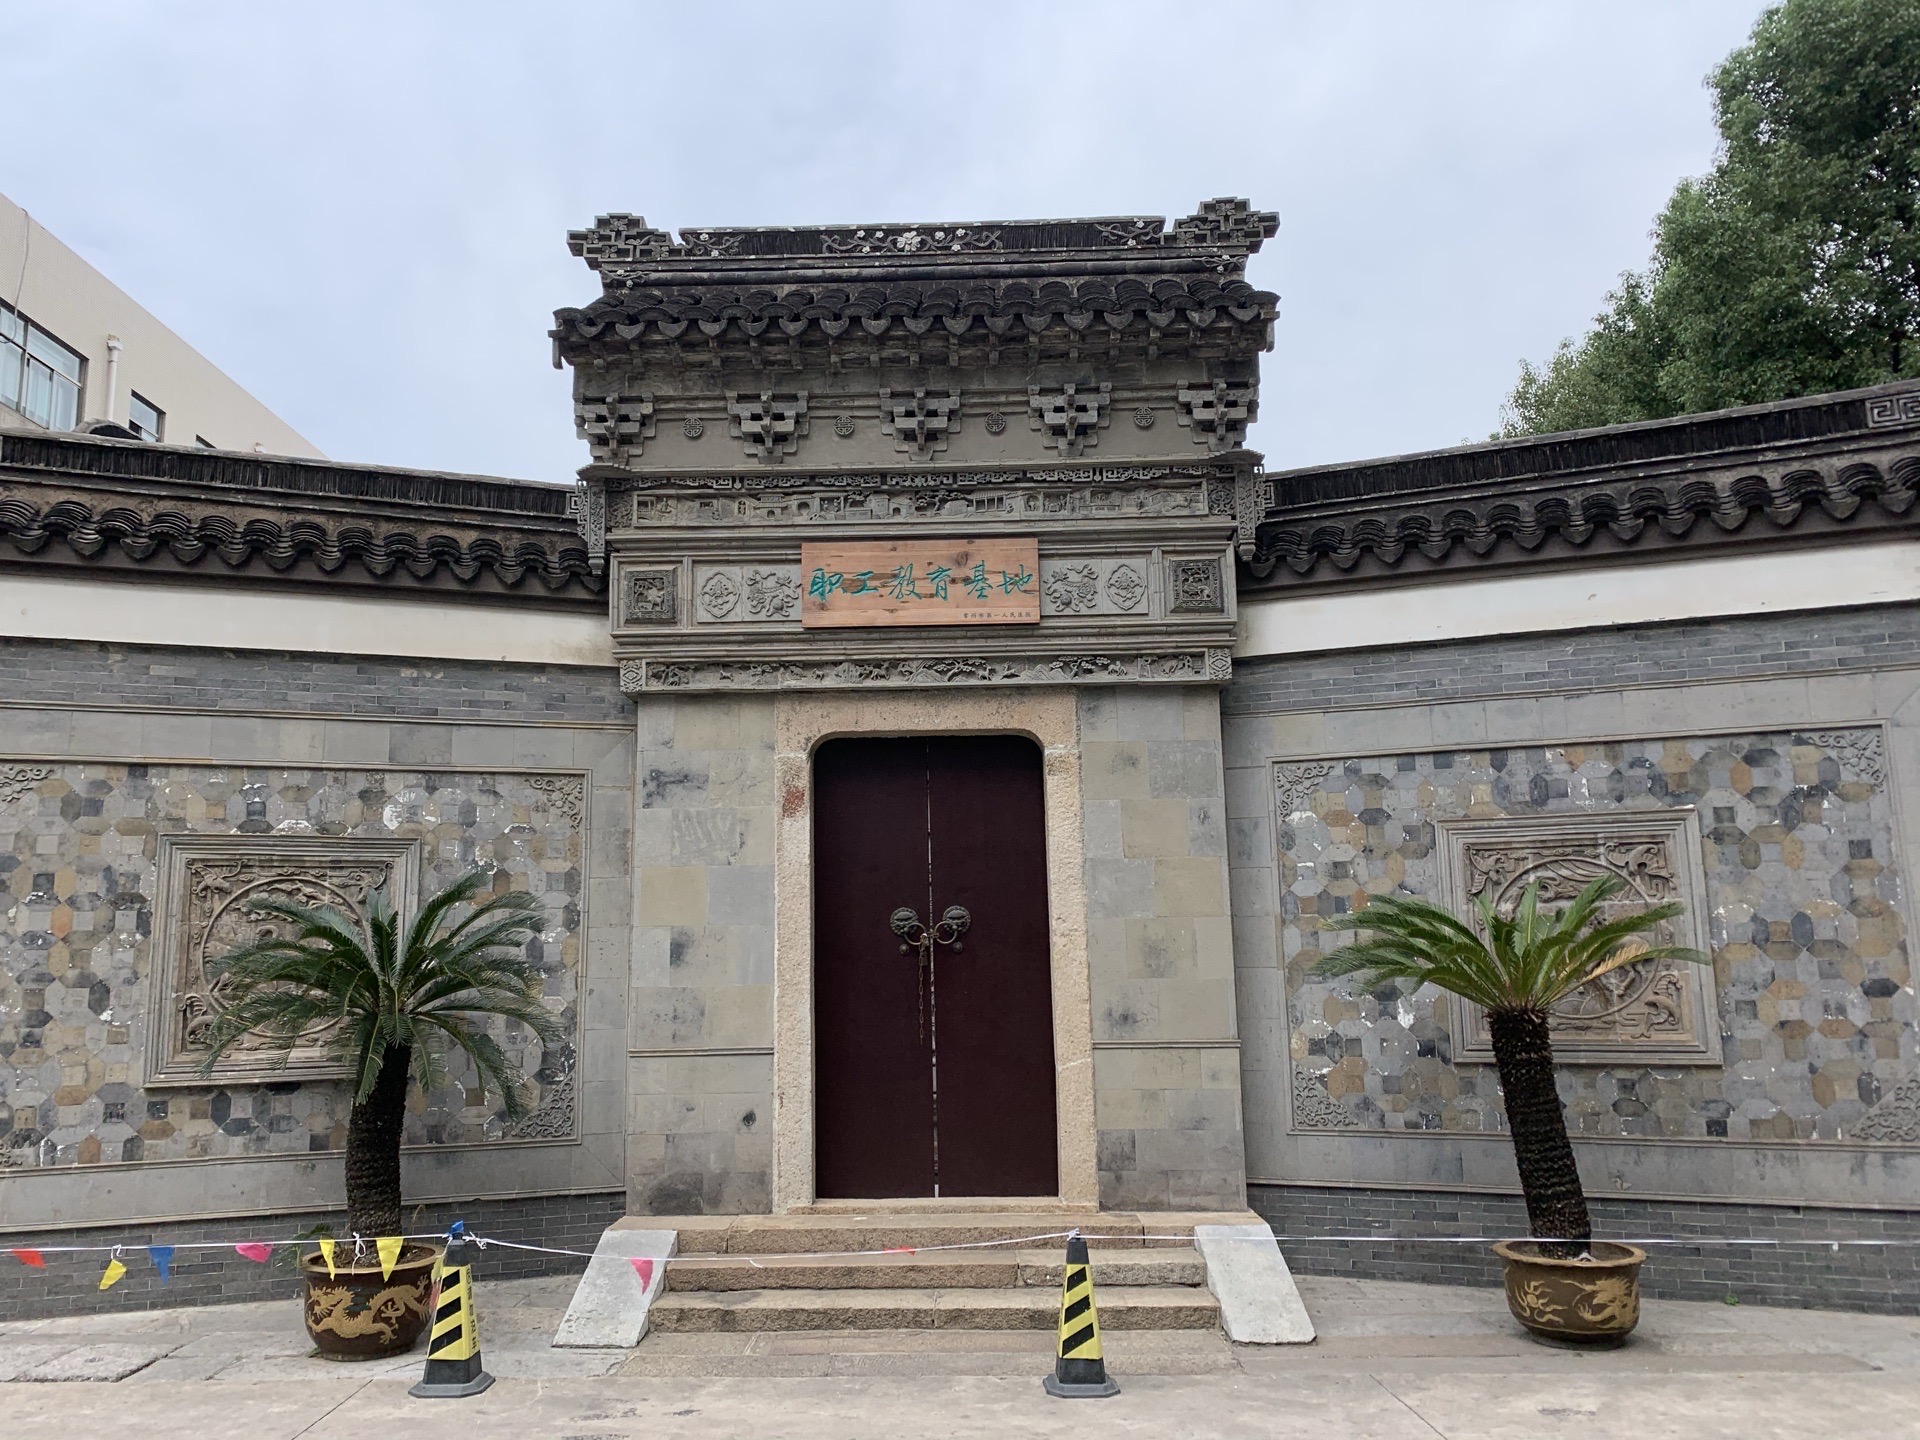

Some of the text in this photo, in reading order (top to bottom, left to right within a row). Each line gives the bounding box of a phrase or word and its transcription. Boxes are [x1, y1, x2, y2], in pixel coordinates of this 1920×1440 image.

[808, 560, 1035, 602] 职工教育基地
